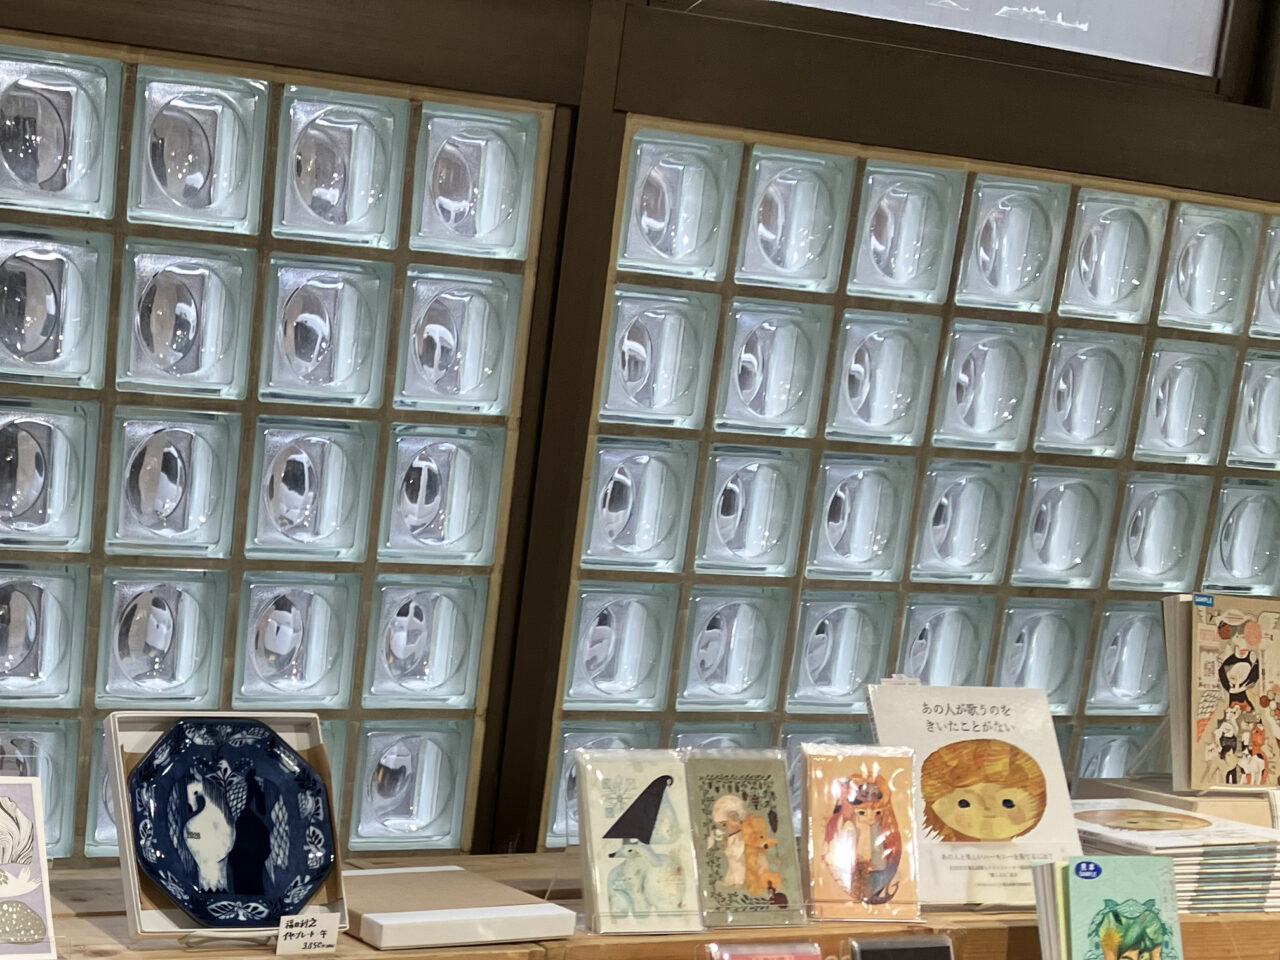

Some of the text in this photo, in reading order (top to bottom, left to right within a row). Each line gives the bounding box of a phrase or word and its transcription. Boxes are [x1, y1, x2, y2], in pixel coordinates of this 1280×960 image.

[922, 701, 1012, 717] あの人が歌うのを
[925, 719, 1016, 733] きいたことがない
